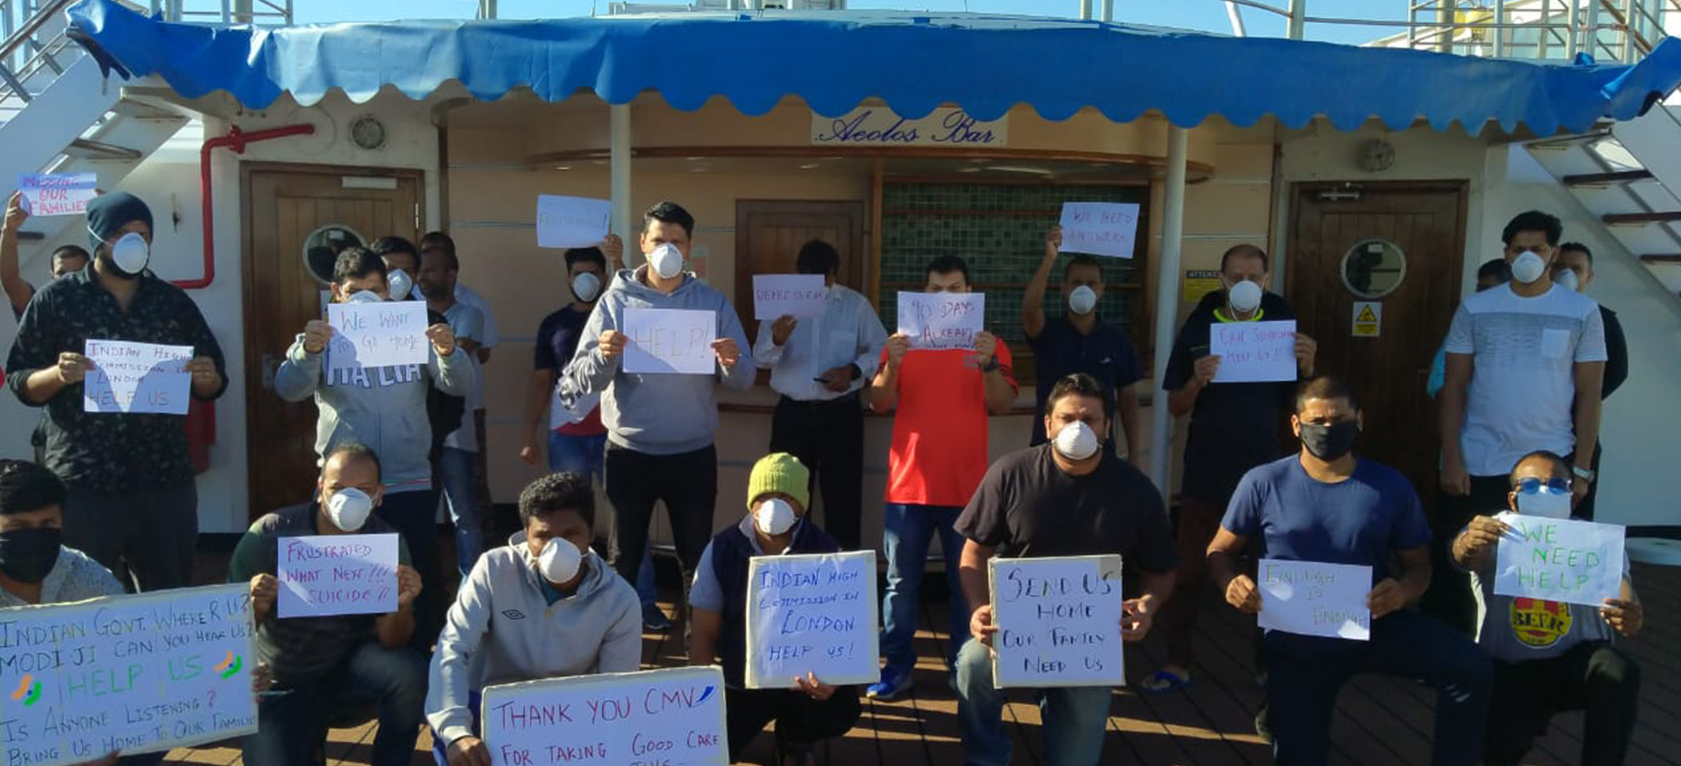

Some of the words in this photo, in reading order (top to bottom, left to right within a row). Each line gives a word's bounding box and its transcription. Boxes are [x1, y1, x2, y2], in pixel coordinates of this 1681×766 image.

[931, 110, 996, 143] Bar
[39, 187, 68, 200] OUR
[341, 310, 367, 331] WE
[379, 310, 413, 328] WANT
[88, 342, 140, 356] INDIAN
[96, 372, 145, 384] LONDON
[89, 390, 136, 406] HELP
[148, 390, 169, 406] US
[1520, 522, 1557, 543] WE
[286, 540, 372, 562] FRUSTRATED
[1532, 547, 1600, 567] NEED
[286, 567, 322, 583] WHAT
[759, 568, 820, 588] INDIAN
[828, 570, 859, 584] HIGH
[1001, 567, 1073, 602] SEND
[1082, 570, 1114, 595] US
[1517, 566, 1589, 590] HELP
[309, 588, 373, 604] SUICIDE
[759, 591, 837, 609] COMMISSION
[842, 592, 859, 600] IN
[1037, 601, 1095, 620] HOME
[0, 620, 86, 648] INDIAN
[153, 603, 206, 630] WHERE
[208, 602, 222, 621] R
[781, 609, 855, 634] LONDON
[1002, 629, 1035, 648] OUR
[1049, 626, 1105, 647] FAMILY
[0, 645, 64, 676] MODI
[114, 639, 153, 658] CAN
[163, 632, 190, 651] YOU
[196, 628, 227, 641] HEAR
[769, 645, 812, 661] HELP
[1023, 657, 1067, 673] NEED
[1085, 656, 1103, 671] US
[66, 663, 143, 699] HELP
[168, 654, 203, 681] US
[492, 701, 573, 730] THANK
[586, 695, 631, 725] YOU
[644, 687, 697, 714] CMV
[1, 718, 29, 743] IS
[44, 707, 109, 737] ANYONE
[126, 697, 200, 725] LISTENING
[8, 747, 59, 766] BRING
[72, 738, 91, 758] US
[102, 732, 145, 755] HOME
[153, 725, 169, 741] TO
[174, 719, 204, 741] OUR
[501, 743, 534, 766] FOR
[548, 742, 606, 764] TAKING
[631, 732, 673, 756] GOOD
[686, 730, 719, 749] CARE
